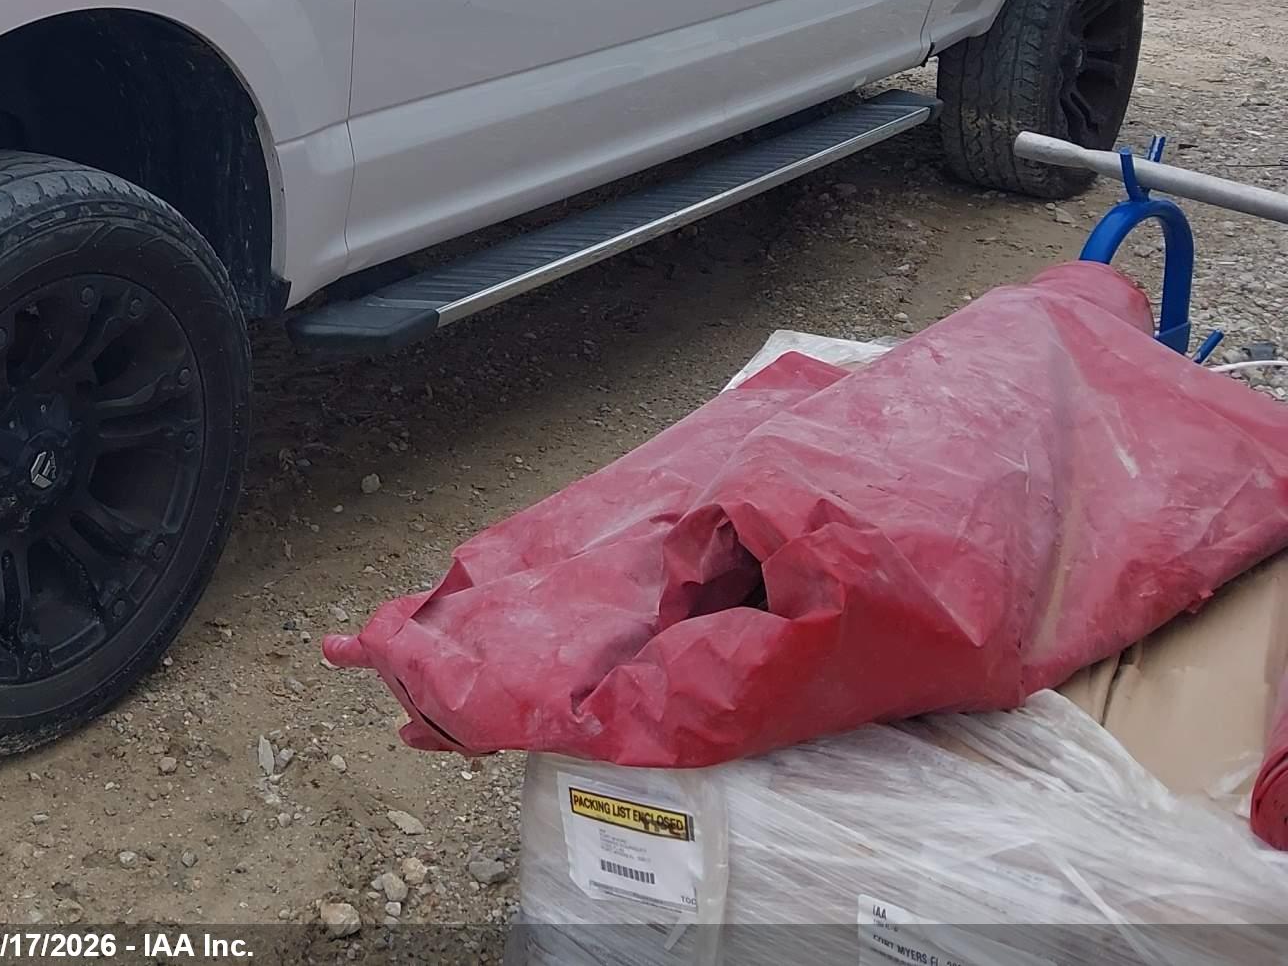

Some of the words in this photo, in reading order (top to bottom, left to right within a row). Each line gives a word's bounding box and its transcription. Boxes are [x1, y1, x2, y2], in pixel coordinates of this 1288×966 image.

[573, 795, 611, 815] PACKING
[612, 805, 632, 820] LIST
[632, 810, 684, 831] ENCLOSED
[872, 905, 887, 921] IAA
[897, 945, 928, 965] MYERS
